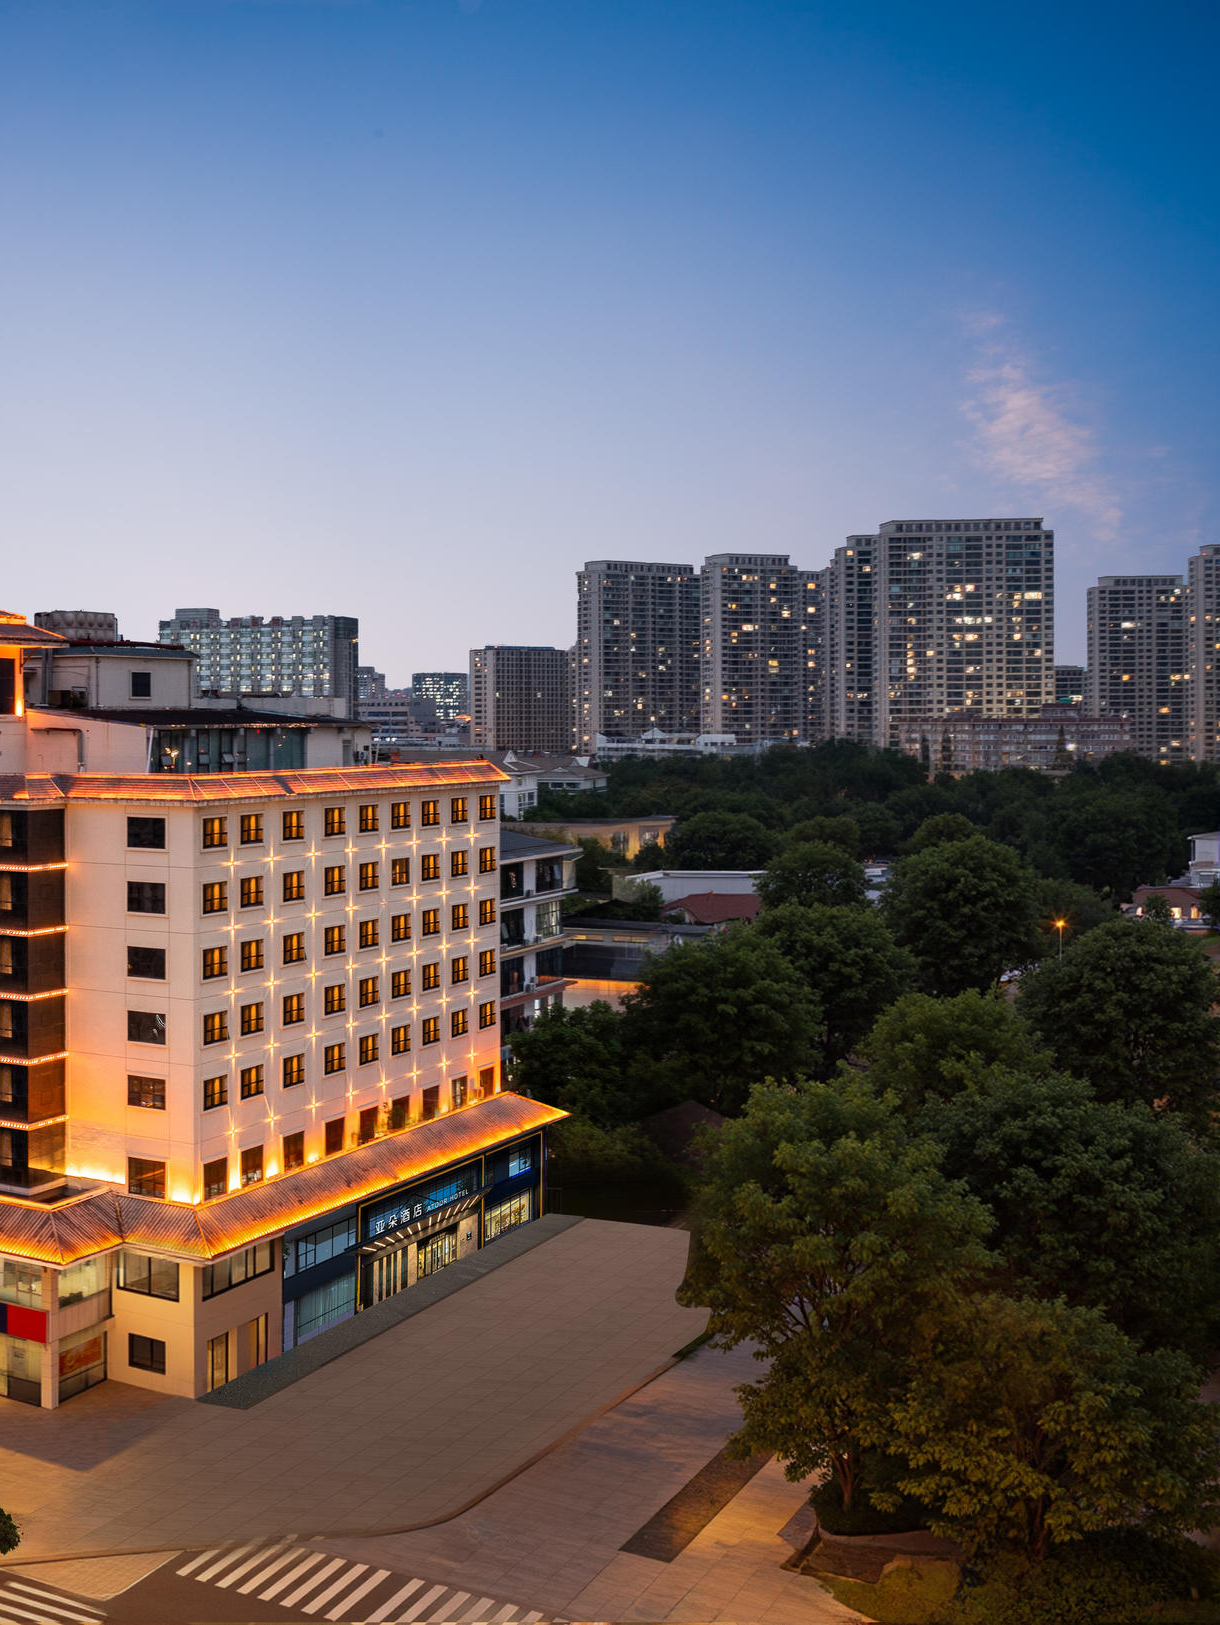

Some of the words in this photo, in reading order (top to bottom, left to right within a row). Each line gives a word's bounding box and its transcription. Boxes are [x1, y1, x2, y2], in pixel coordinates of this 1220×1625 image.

[427, 1198, 448, 1212] ATOUR
[449, 1189, 469, 1201] HOTEL
[375, 1203, 423, 1235] 亚朵酒店
